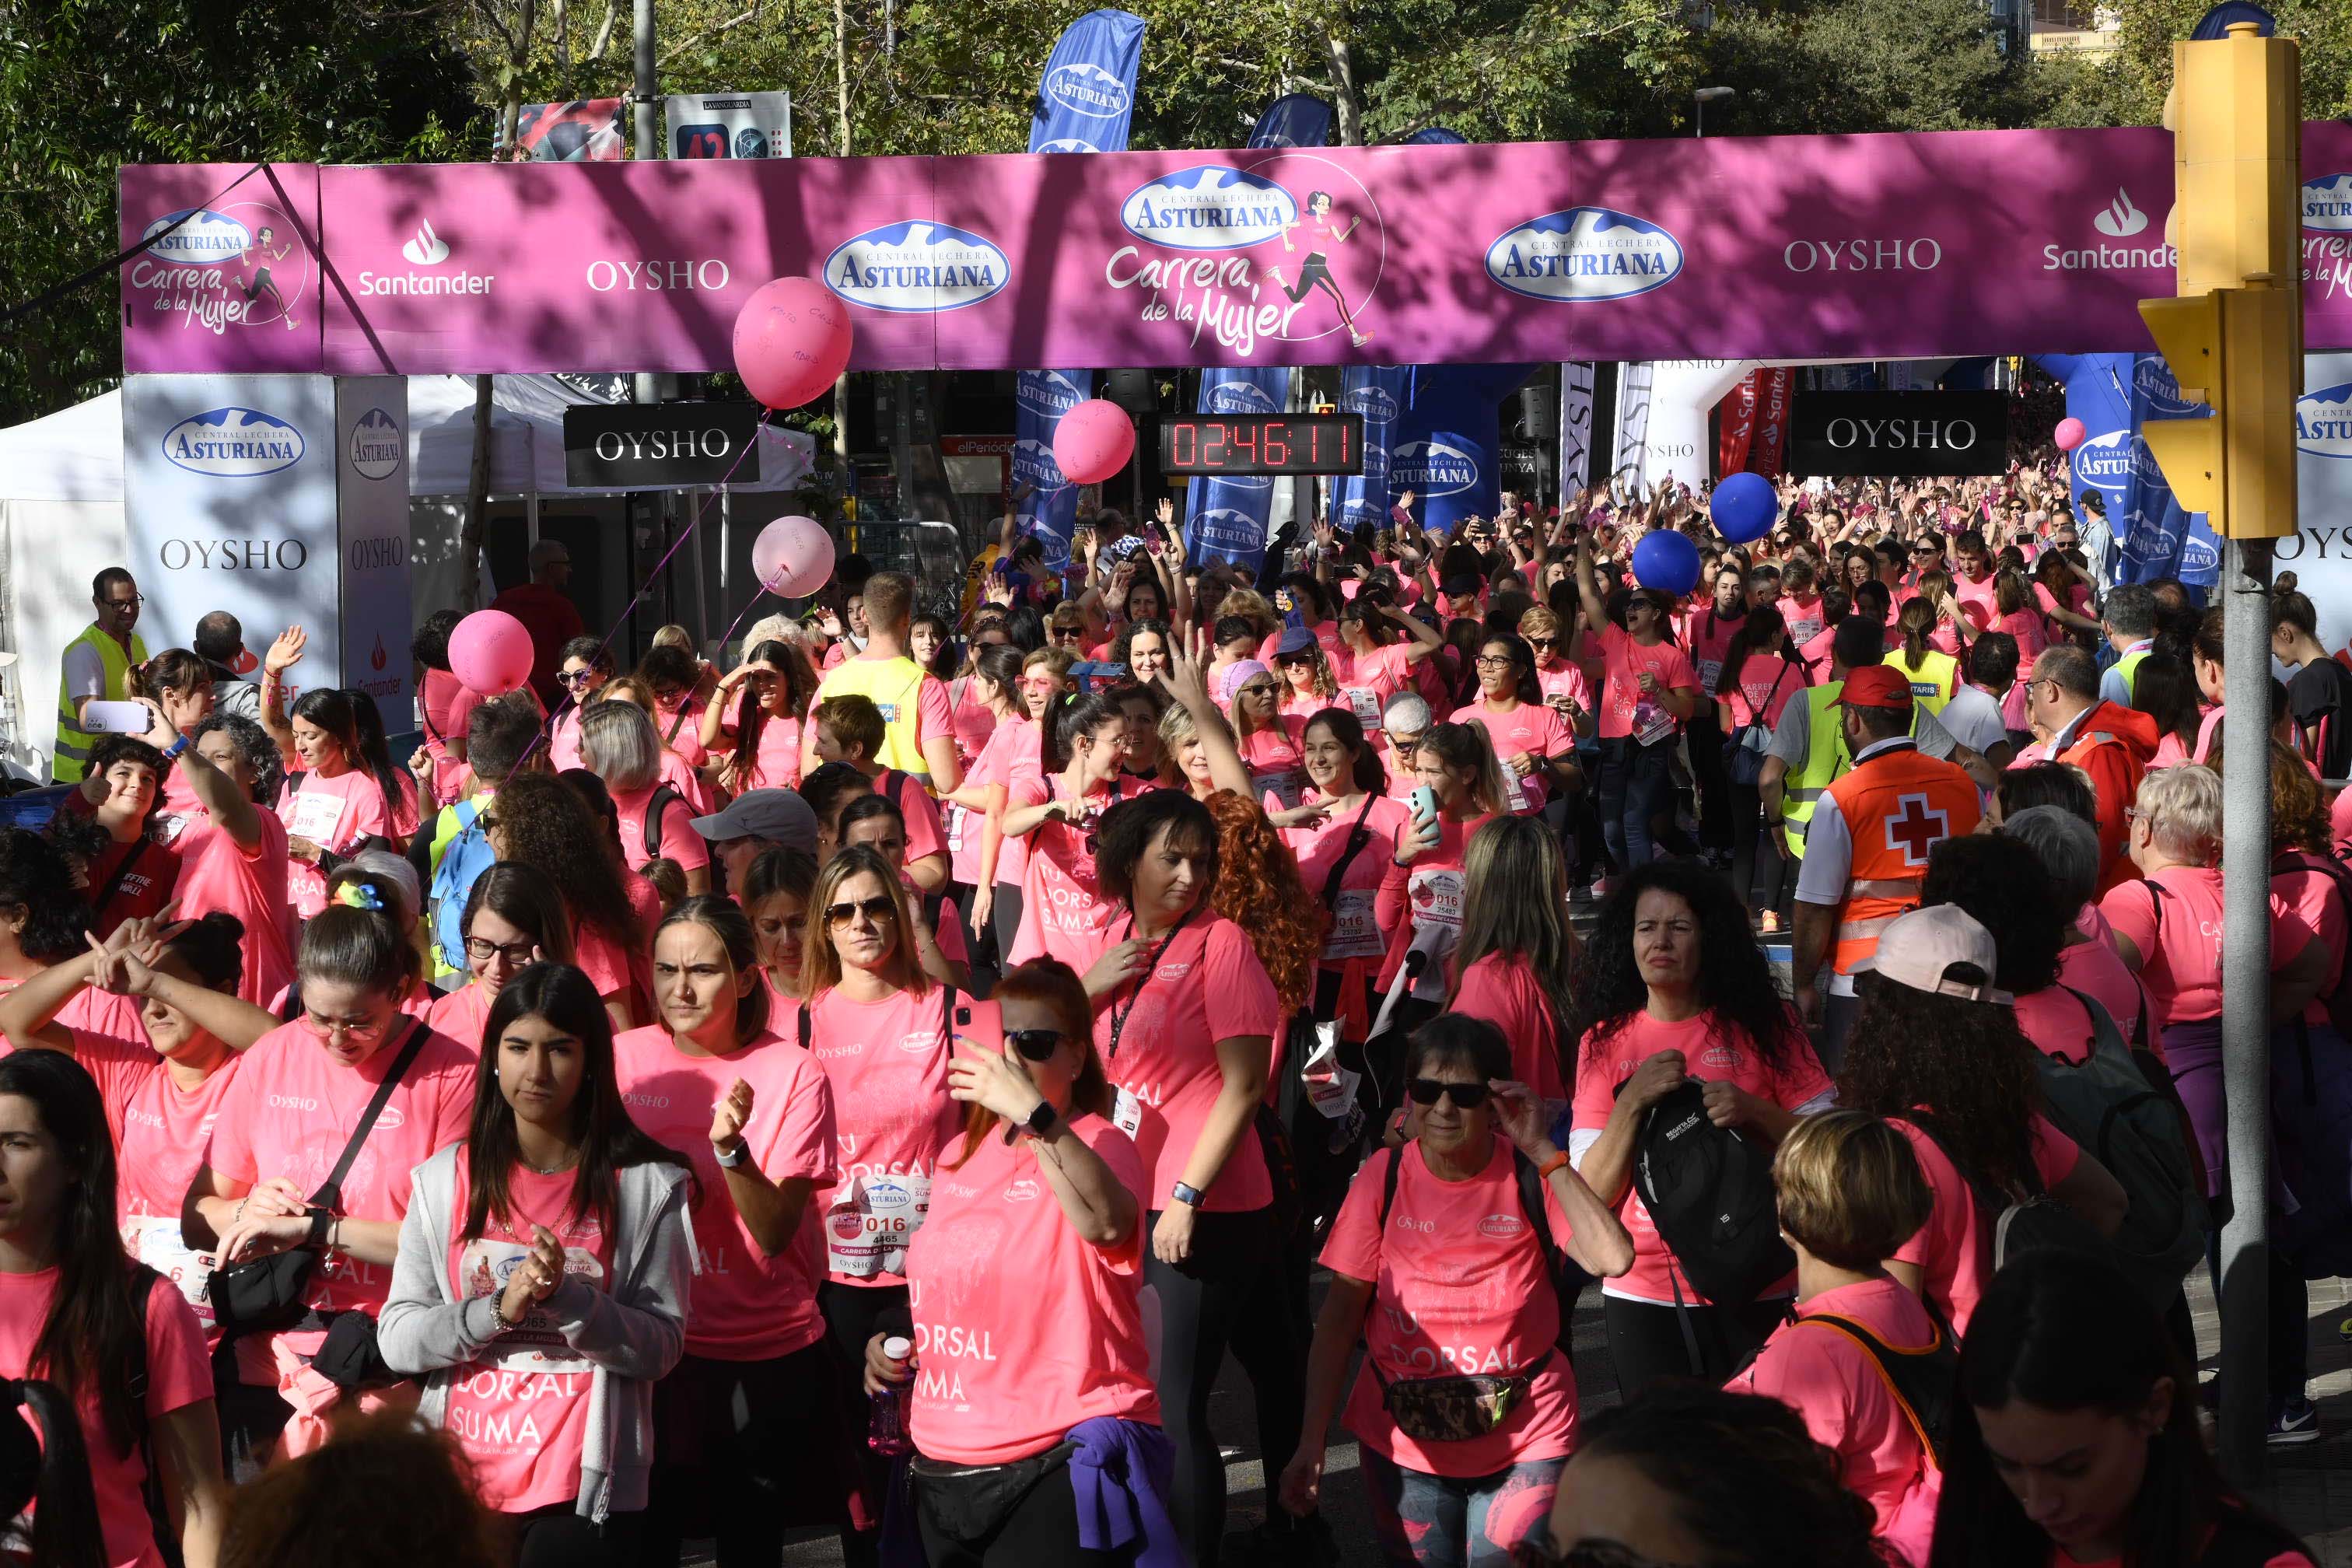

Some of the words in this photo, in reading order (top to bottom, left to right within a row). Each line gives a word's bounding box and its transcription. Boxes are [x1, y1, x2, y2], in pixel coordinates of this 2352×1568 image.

[1161, 194, 1217, 204] CENTRAL
[1222, 193, 1278, 202] LECHERA
[2301, 202, 2352, 217] STUR
[1134, 198, 1283, 229] ASTURIANA
[148, 229, 243, 250] ASTURIANA
[1531, 239, 1591, 250] CENTRAL
[1598, 238, 1662, 248] LECHERA
[866, 252, 925, 261] CENTRAL
[929, 251, 989, 261] LECHERA
[1500, 243, 1668, 278] ASTURIANA
[1784, 237, 1942, 273] OYSHO
[131, 260, 223, 289] Carrera
[586, 259, 730, 292] OYSHO
[837, 254, 996, 289] ASTURIANA
[1106, 245, 1251, 289] Carrera
[2315, 259, 2329, 281] la
[359, 271, 495, 296] Santander
[154, 292, 171, 310] de
[174, 291, 187, 311] la
[184, 287, 258, 335] Mujer
[1142, 291, 1168, 321] de
[1174, 289, 1194, 321] la
[1189, 282, 1305, 357] Mujer
[596, 429, 730, 461] OYSHO
[1174, 424, 1346, 465] 02:46:11
[1826, 418, 1976, 450] OYSHO
[174, 433, 296, 460] ASTURIANA
[354, 440, 399, 463] ASTURIANA
[1014, 458, 1072, 485] STURIANA
[2081, 453, 2128, 474] ASTU
[1390, 468, 1471, 484] STURIANA
[1195, 523, 1260, 548] ASTURIANA
[160, 539, 307, 571] OYSHO
[352, 536, 403, 570] OYSHO
[1040, 864, 1061, 882] TU
[119, 883, 142, 896] WALL
[1437, 894, 1458, 906] 016
[1043, 908, 1094, 929] SUMA
[1339, 916, 1363, 927] 016
[1437, 906, 1456, 915] 25483
[2200, 921, 2224, 937] CA
[817, 1044, 861, 1059] OYSHO
[269, 1094, 317, 1111] OYSHO
[621, 1092, 670, 1108] OYSHO
[1666, 1120, 1689, 1138] REGATTA
[866, 1217, 905, 1232] 016
[1482, 1222, 1521, 1233] ASTURIANA
[564, 1265, 592, 1273] SUMA
[840, 1260, 873, 1269] OYSHO
[1391, 1343, 1518, 1376] DORSAL
[456, 1370, 579, 1402] DORSAL
[915, 1368, 966, 1401] MA
[452, 1405, 541, 1445] SUMA
